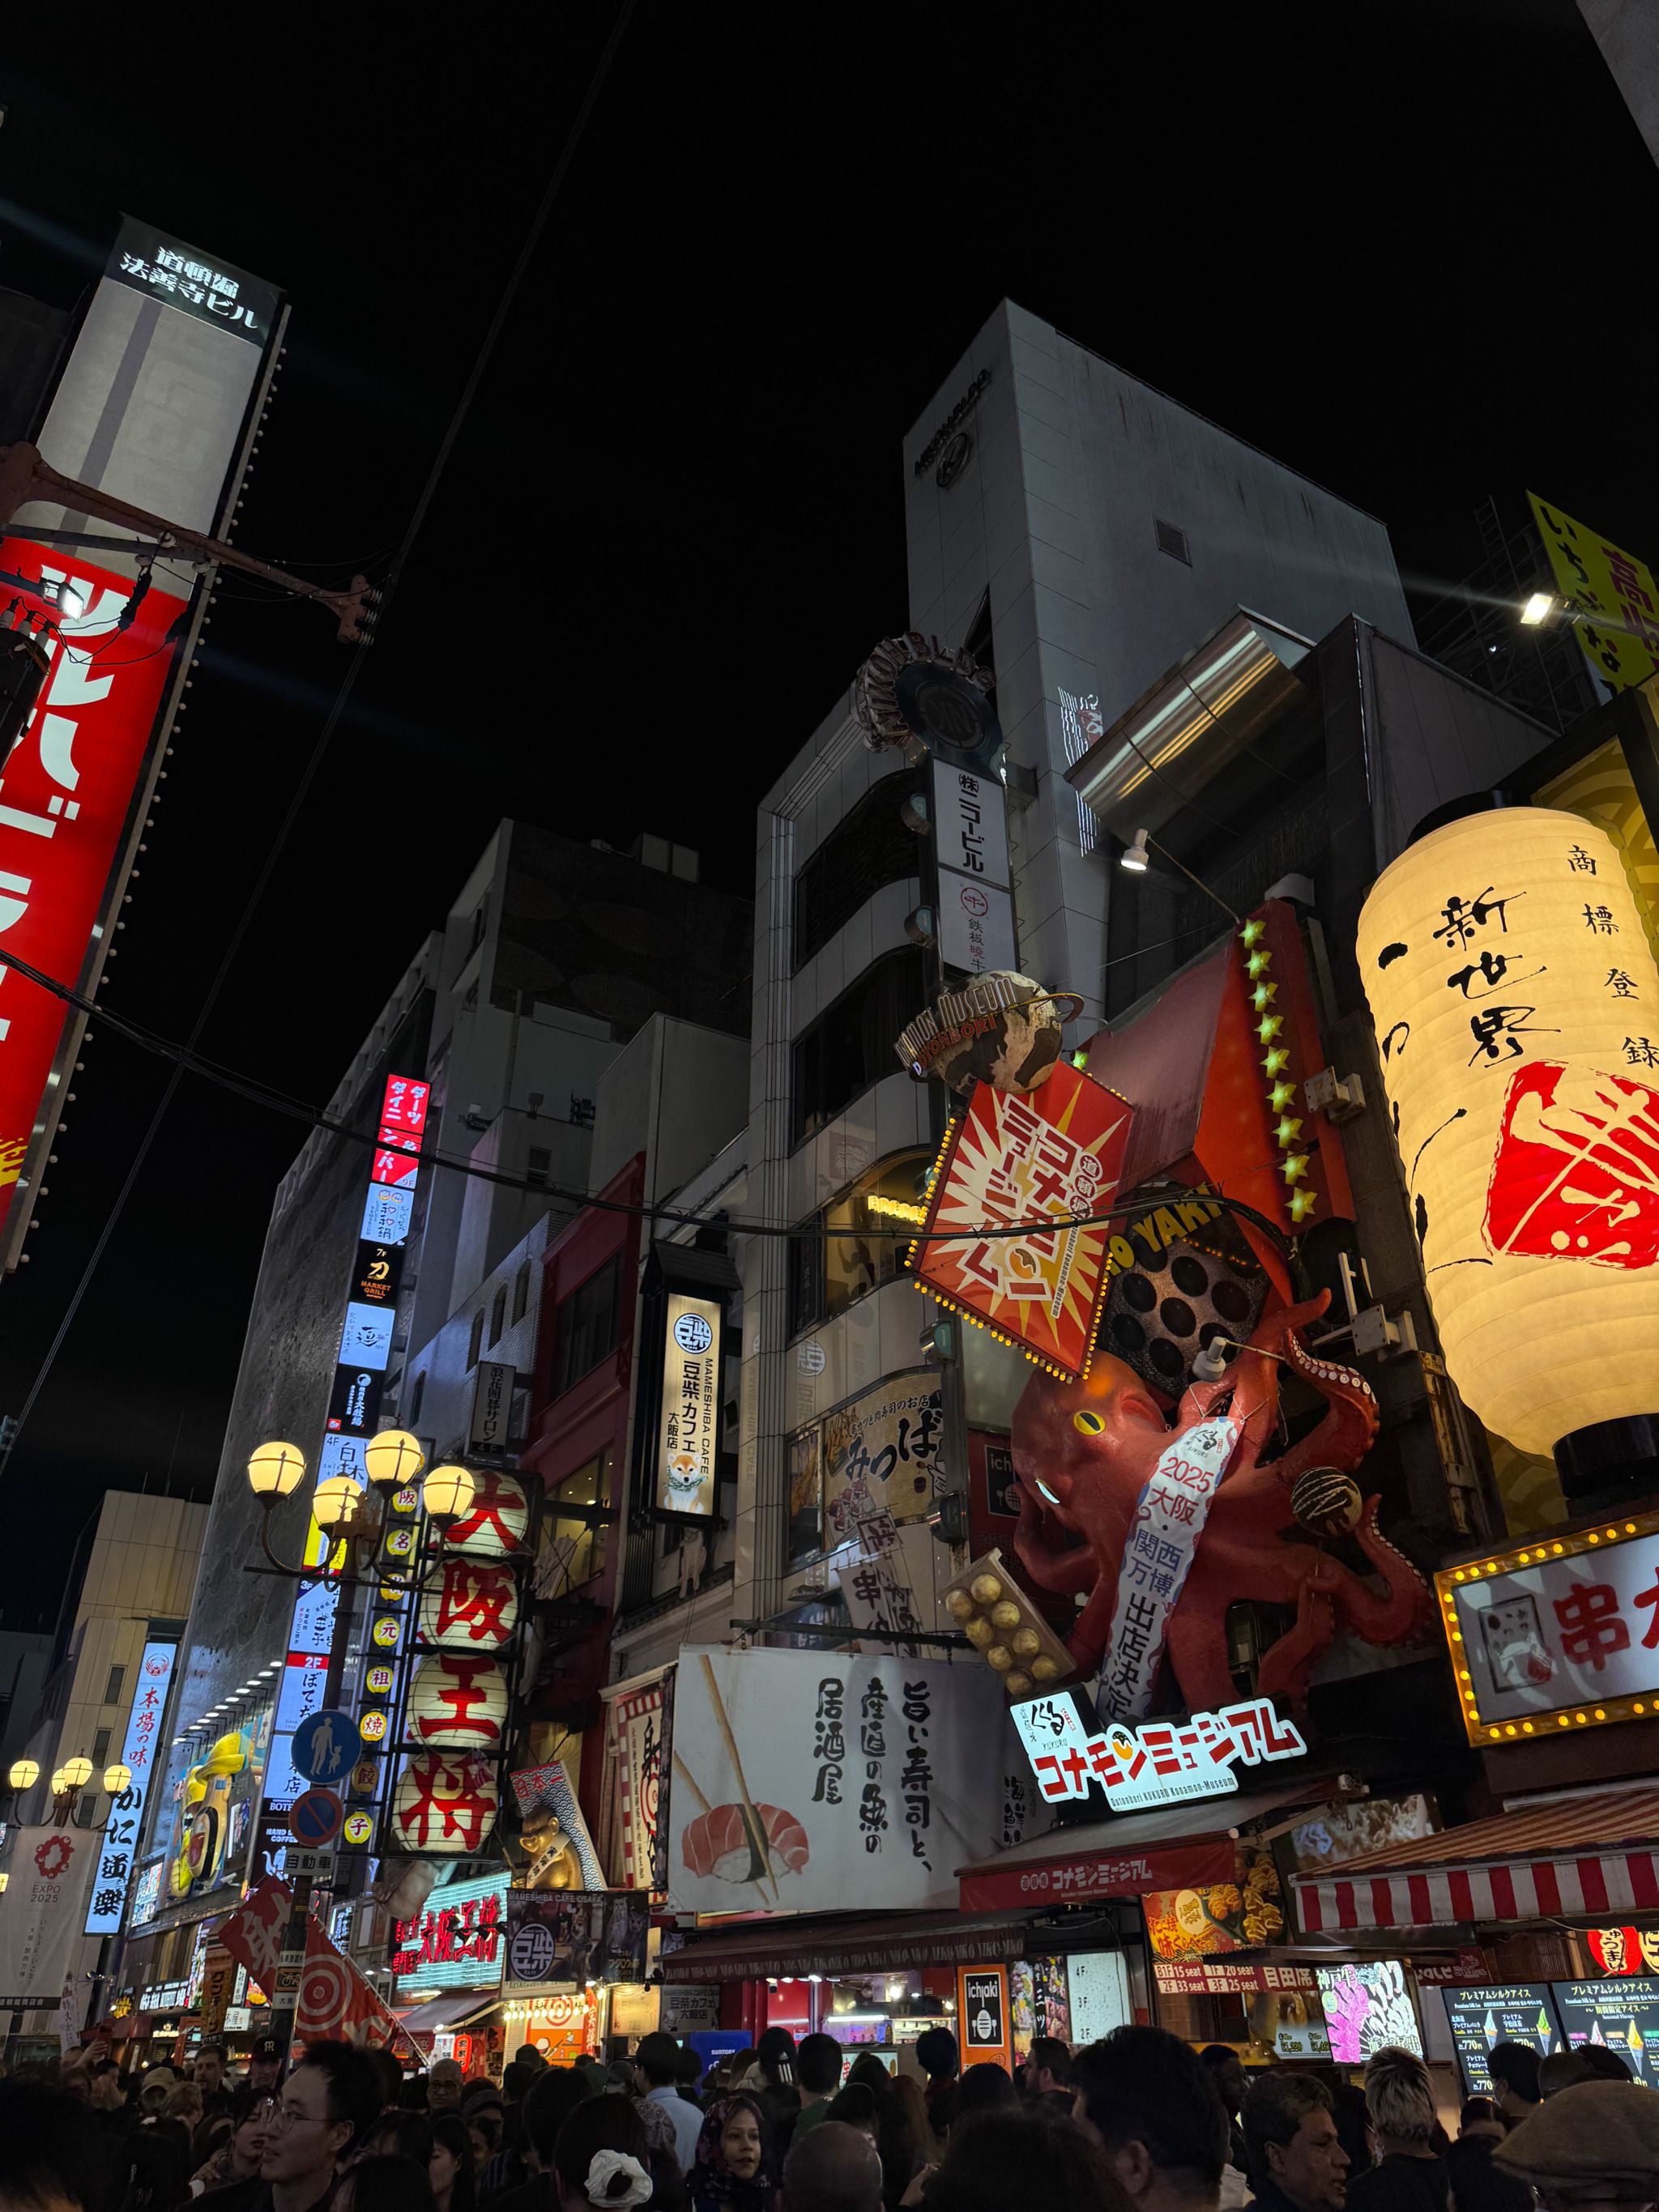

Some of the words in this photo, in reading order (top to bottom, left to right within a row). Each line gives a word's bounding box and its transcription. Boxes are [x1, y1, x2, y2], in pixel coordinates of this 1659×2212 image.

[120, 251, 258, 328] 法善寺ビル
[155, 246, 239, 299] 道頓堀
[1567, 845, 1659, 1069] 商標登録
[1432, 885, 1561, 1069] 新世界
[937, 978, 1017, 1028] MUSEUM
[912, 1012, 999, 1076] DOTONBORI
[377, 1081, 407, 1183] ダイニンバー
[403, 1178, 415, 1187] 9F
[1069, 1153, 1102, 1220] 道頓堀
[1008, 1129, 1079, 1298] コナモン
[1132, 1182, 1224, 1253] YAKI
[360, 1281, 392, 1291] MARKET
[364, 1287, 386, 1297] GRILL
[681, 1361, 702, 1453] 豆柴カフェ
[702, 1357, 714, 1434] MAMESHIBA
[327, 1436, 340, 1447] 4F
[667, 1412, 680, 1450] 大阪店
[846, 1409, 943, 1481] みつば
[700, 1438, 710, 1475] CAFE
[1159, 1456, 1214, 1494] 2025
[1148, 1486, 1200, 1528] 大阪
[1134, 1528, 1184, 1572] 関西
[301, 1580, 313, 1590] 3F
[1127, 1556, 1175, 1599] 万博
[305, 1656, 322, 1669] 2F
[399, 1468, 526, 1850] 大阪王将
[1105, 1592, 1158, 1722] 出店決定
[129, 1686, 160, 1768] 本場の味
[1031, 1700, 1064, 1737] くくる
[812, 1677, 846, 1805] 居酒屋
[1034, 1706, 1300, 1796] コナモンミュージアム
[1042, 1738, 1069, 1752] KUKURU
[860, 1677, 889, 1854] 産直の魚の
[901, 1681, 933, 1872] 旨い寿司と、
[514, 1774, 565, 1799] 日本一
[1111, 1792, 1142, 1807] Dotonbori
[1143, 1788, 1169, 1802] KUKURU
[1169, 1777, 1235, 1796] Konamon-Museum
[286, 1854, 332, 1870] 自動車
[1052, 1860, 1154, 1890] コナモンミュージアム
[30, 1894, 58, 1903] 2025
[32, 1885, 61, 1894] EXPO
[510, 1893, 553, 1903] MAMESHIBA
[555, 1894, 576, 1903] CAFE
[1076, 1966, 1085, 1977] 4F
[1158, 1967, 1174, 1978] B1F
[1175, 1966, 1184, 1977] 15
[1185, 1967, 1202, 1977] seat
[1225, 1965, 1237, 1976] 20
[1238, 1966, 1255, 1976] seat
[1163, 1981, 1173, 1993] 2F
[1177, 1981, 1188, 1992] 33
[1189, 1982, 1205, 1992] seat
[1213, 1980, 1223, 1990] 3F
[1228, 1980, 1240, 1991] 25
[1241, 1980, 1259, 1991] seat
[1316, 1967, 1352, 1990] 神戸牛
[1571, 1982, 1653, 1996] プレミアムシルクアイス
[670, 1997, 715, 2009] 豆柴カフェ
[1078, 1997, 1088, 2008] 3F
[1460, 1988, 1532, 2001] プレミアムシルクアイス
[1081, 2028, 1090, 2039] 2F
